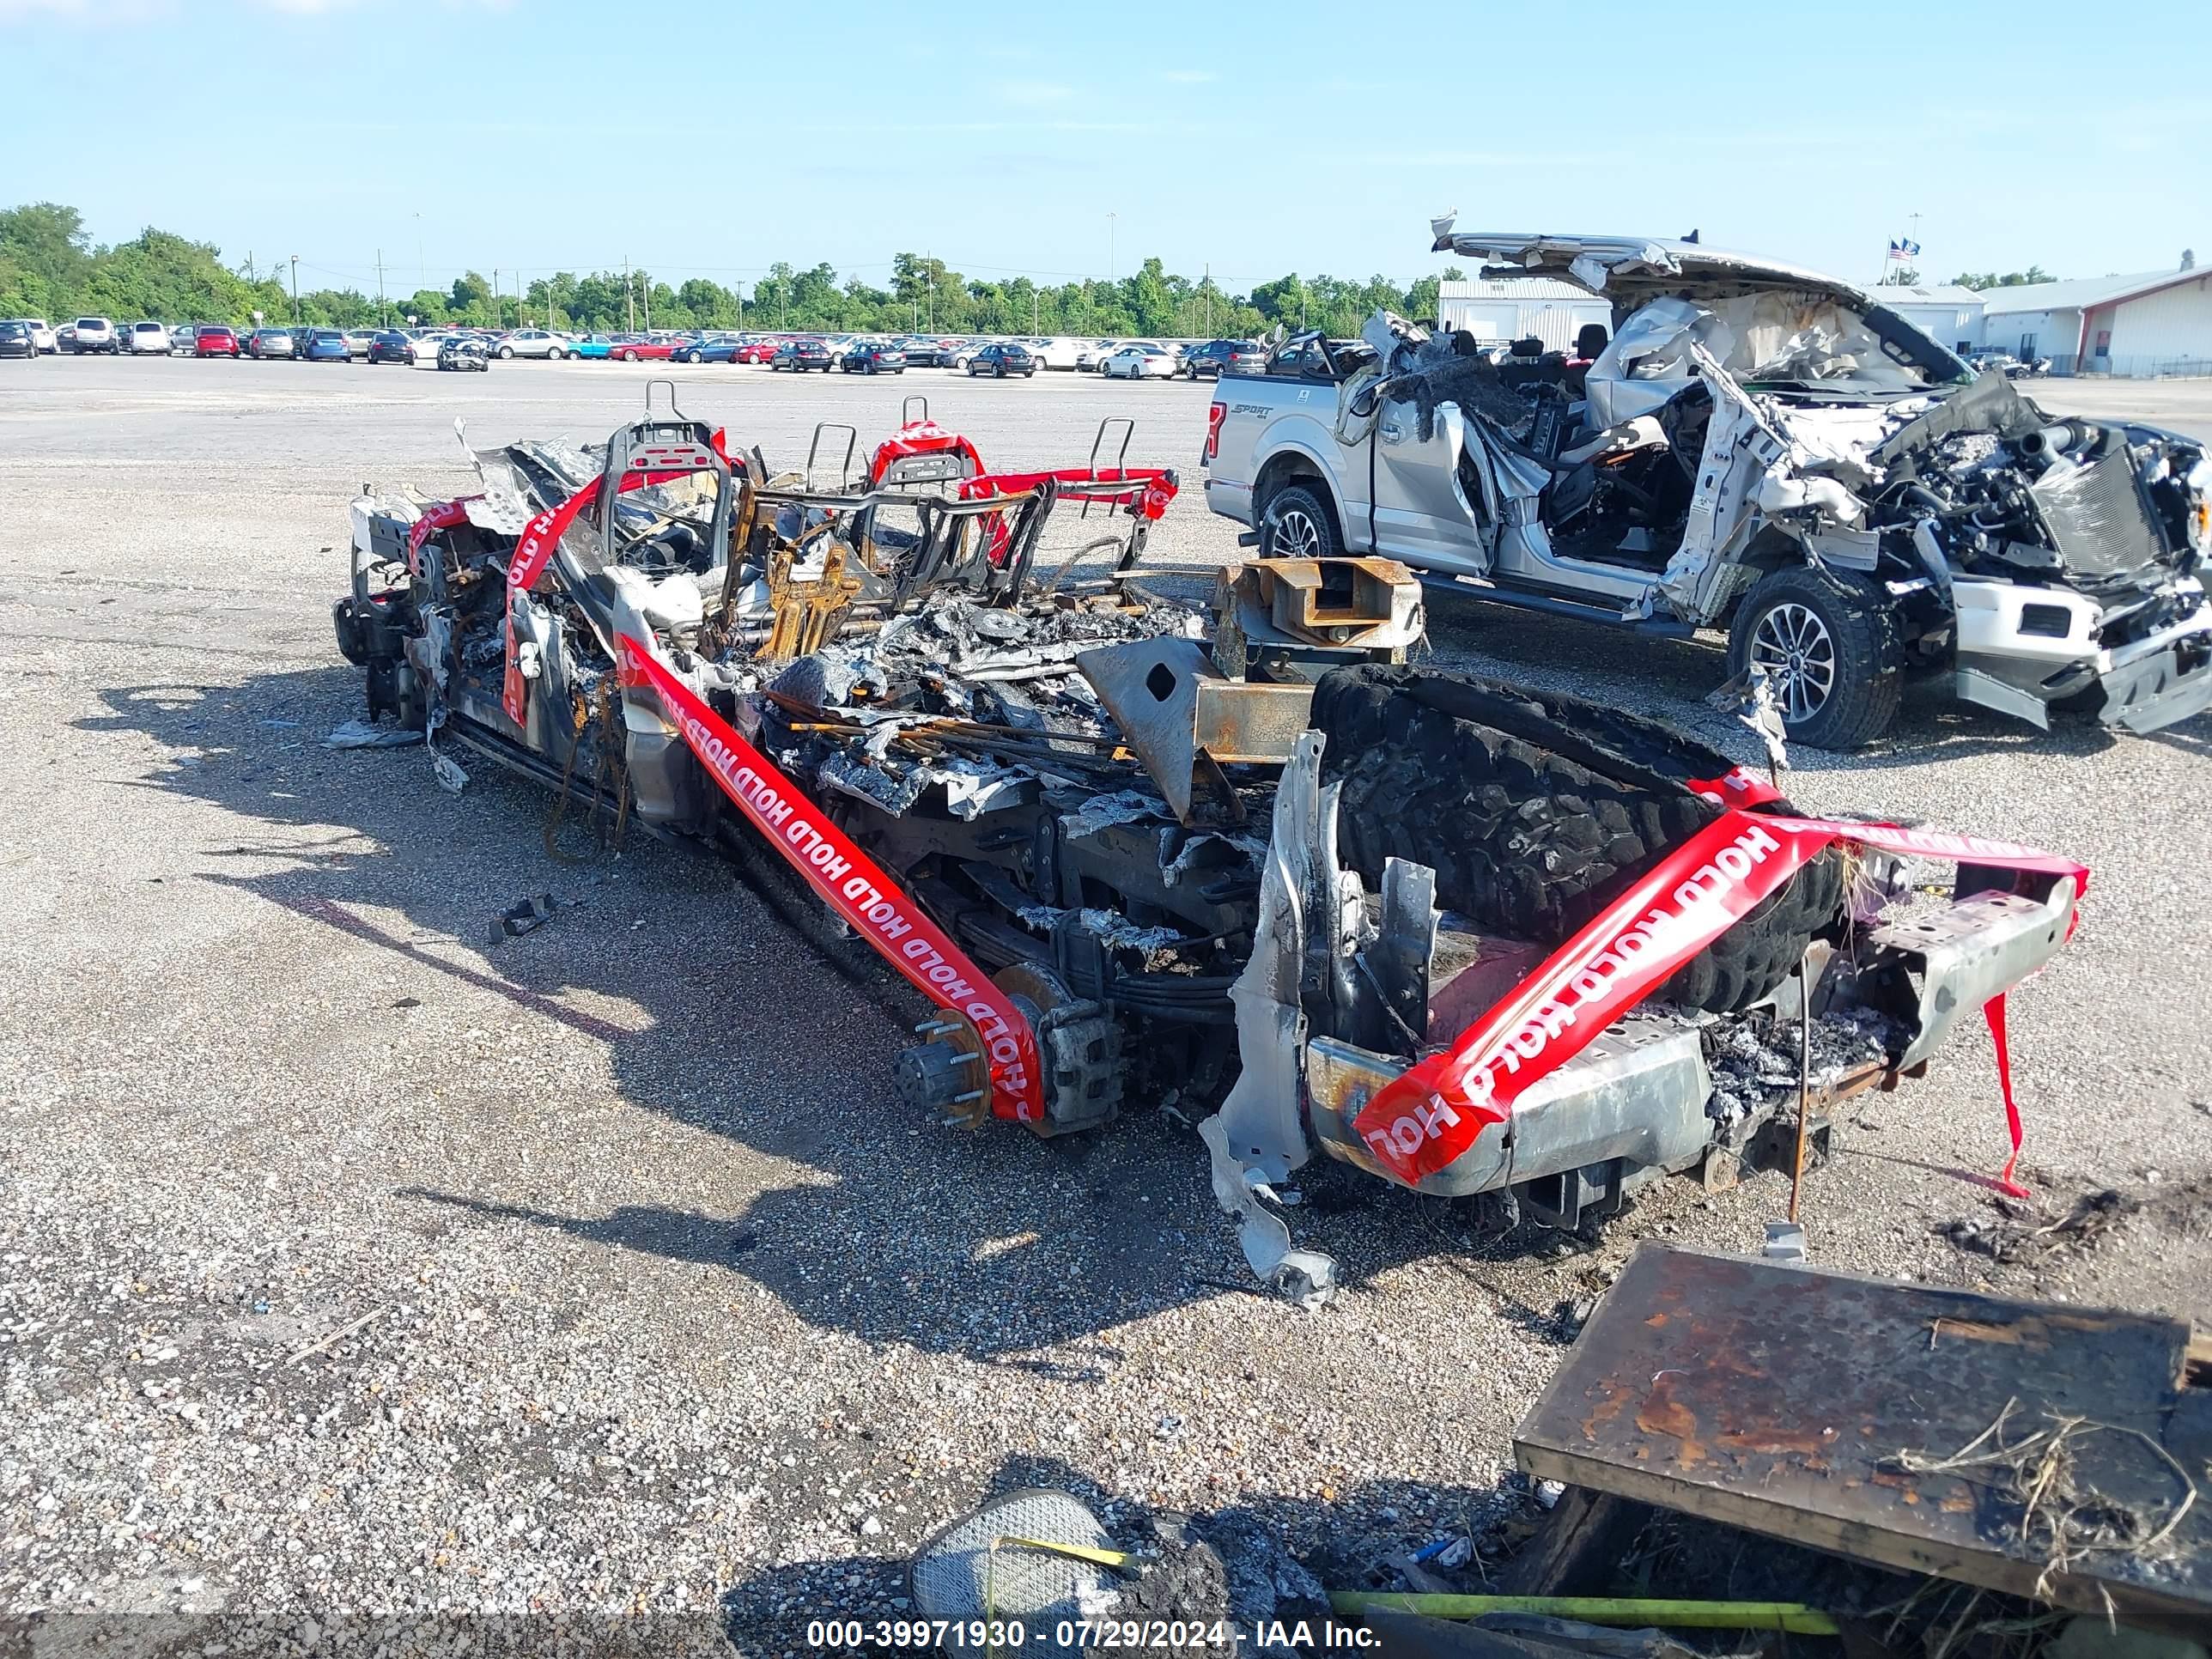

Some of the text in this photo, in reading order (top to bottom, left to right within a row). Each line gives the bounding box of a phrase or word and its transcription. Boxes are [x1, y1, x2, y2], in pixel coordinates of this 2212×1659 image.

[1231, 404, 1274, 415] SPORT
[733, 767, 794, 827] HOLD
[786, 819, 853, 881] HOLD
[1674, 825, 1781, 915] HOLD
[842, 877, 913, 939] HOLD
[902, 939, 976, 1000] HOLD
[1570, 908, 1678, 1003] HOLD
[966, 1002, 1028, 1097] HOLD
[1462, 1000, 1578, 1106] HOLD
[1362, 1092, 1462, 1160] HOL
